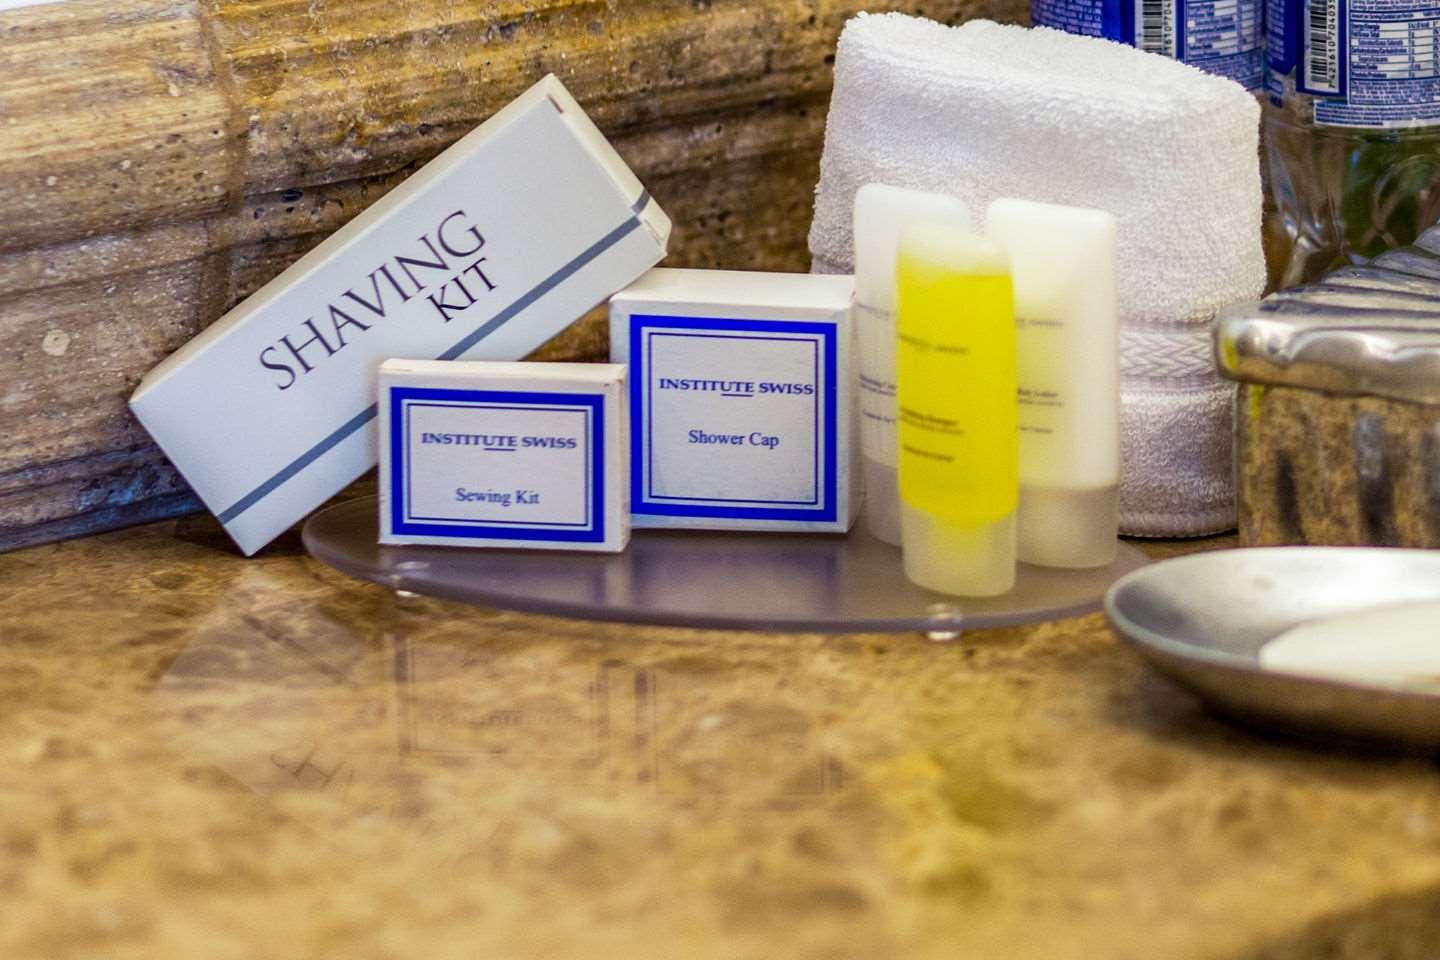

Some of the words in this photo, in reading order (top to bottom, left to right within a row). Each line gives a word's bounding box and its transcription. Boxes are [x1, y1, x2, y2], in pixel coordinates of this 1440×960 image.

[259, 210, 486, 390] SHAVING
[426, 257, 496, 323] KIT
[659, 378, 754, 393] INSTITUTE
[758, 382, 815, 395] SWISS
[421, 432, 518, 448] INSTITUTE
[521, 436, 578, 449] SWISS
[688, 429, 745, 446] Shower
[749, 432, 780, 450] Cap
[456, 487, 512, 507] Sewing
[515, 489, 540, 505] Kit
